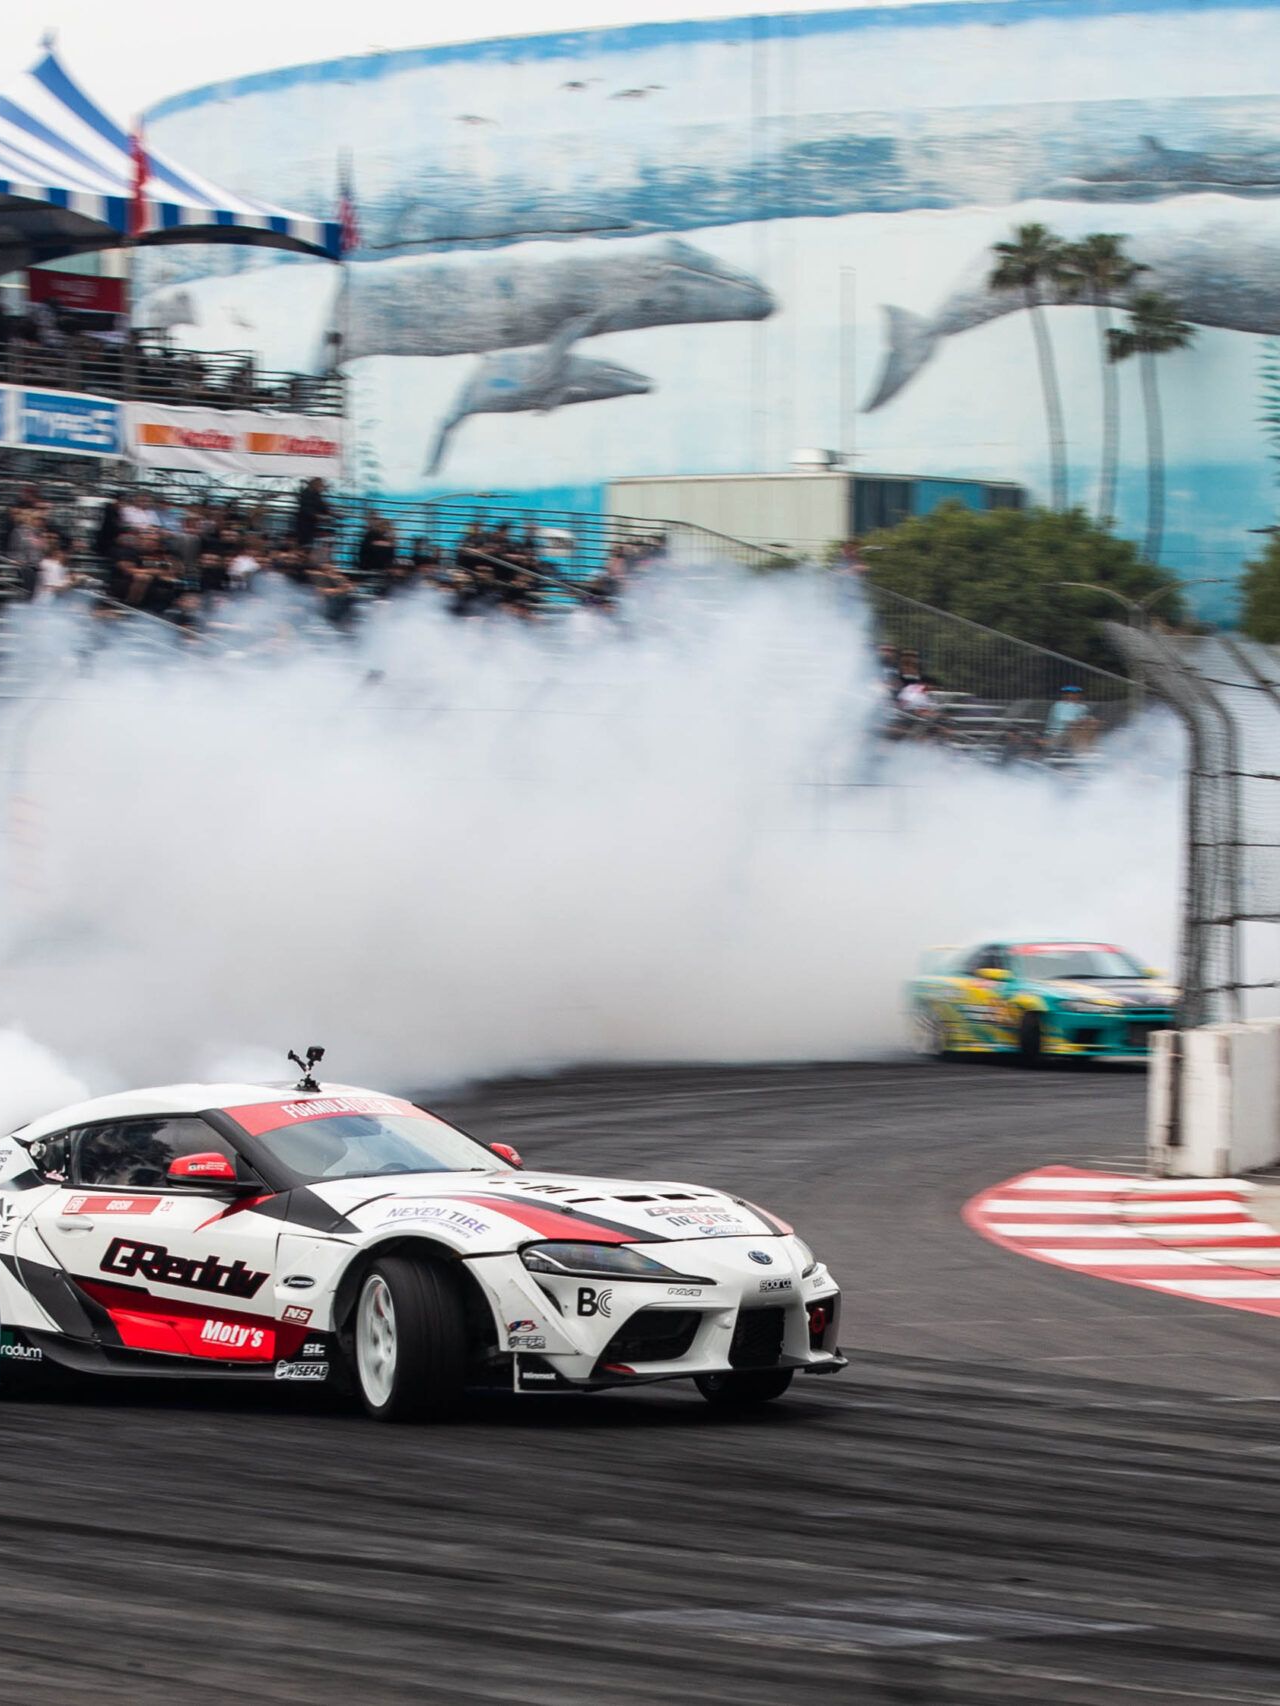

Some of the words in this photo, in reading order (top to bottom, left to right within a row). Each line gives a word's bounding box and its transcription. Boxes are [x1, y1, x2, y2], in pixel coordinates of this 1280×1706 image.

[386, 1207, 447, 1217] NEXEN
[448, 1211, 490, 1234] TIRE
[100, 1237, 271, 1299] GReddy
[285, 1307, 310, 1320] NS
[201, 1320, 264, 1347] Moty's
[0, 1342, 42, 1358] radium
